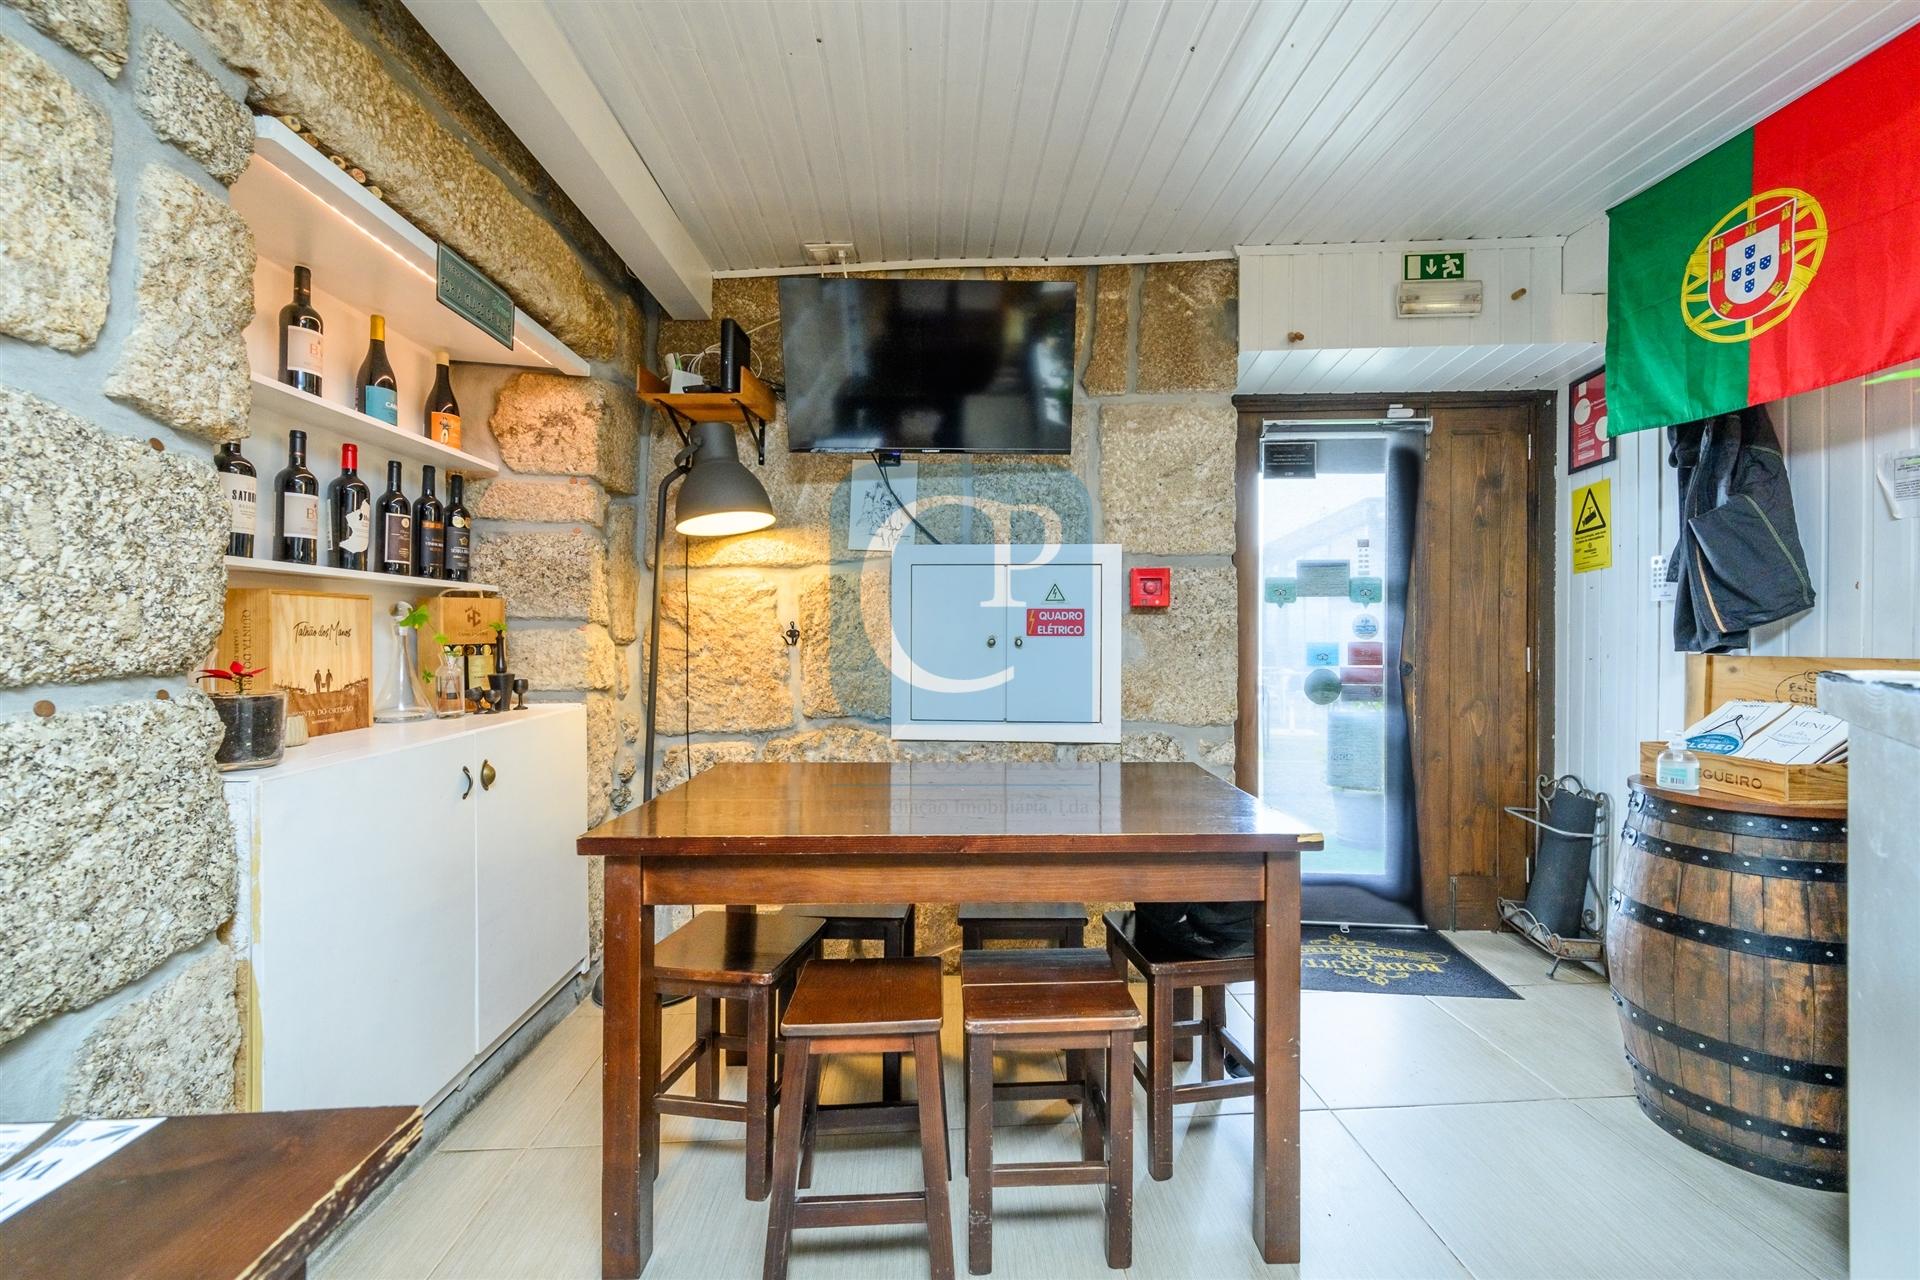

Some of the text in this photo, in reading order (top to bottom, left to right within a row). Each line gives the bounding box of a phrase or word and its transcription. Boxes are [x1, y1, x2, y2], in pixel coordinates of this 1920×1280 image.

[1038, 611, 1083, 621] QUADRO
[1037, 622, 1083, 635] ELÉTRICO
[1687, 741, 1735, 751] LOSED
